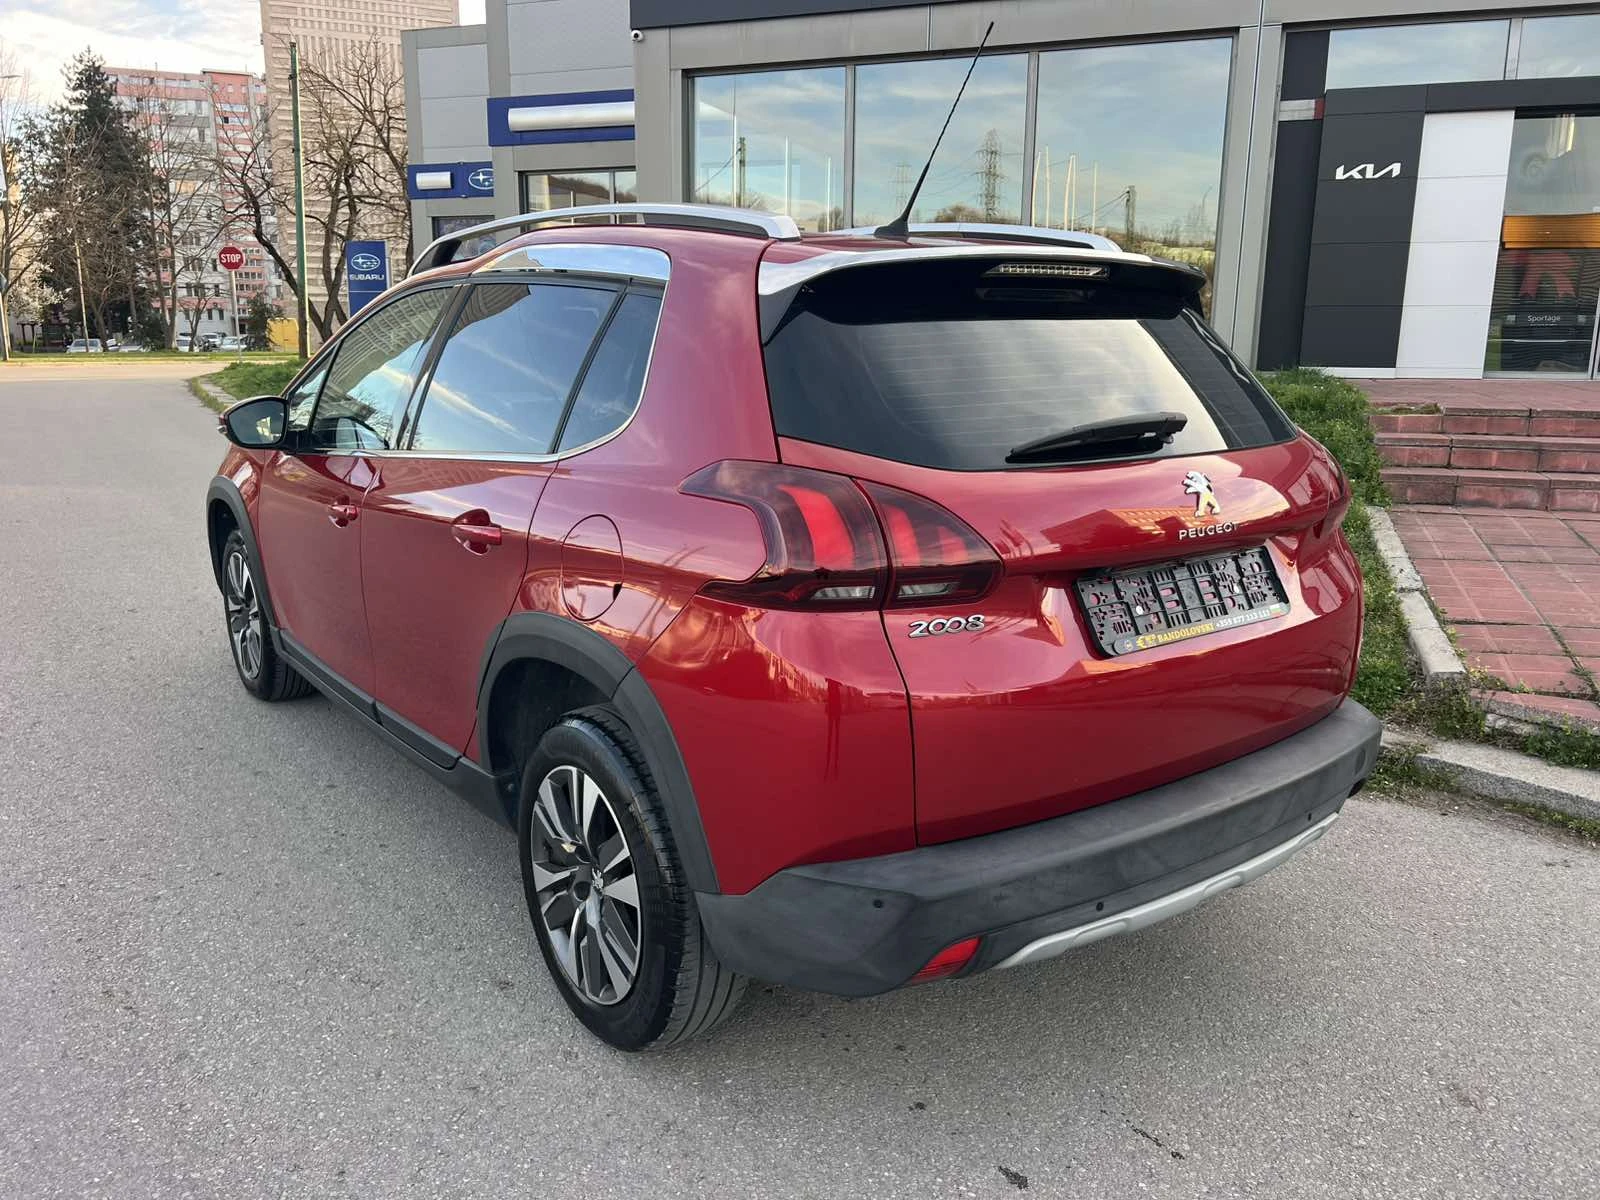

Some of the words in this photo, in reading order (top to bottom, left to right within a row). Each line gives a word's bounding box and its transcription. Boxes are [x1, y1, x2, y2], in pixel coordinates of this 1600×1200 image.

[1335, 162, 1402, 180] KIA
[220, 253, 241, 263] STOP
[349, 273, 385, 281] SUBARU
[1527, 314, 1561, 323] Sportage
[908, 614, 985, 639] 2008
